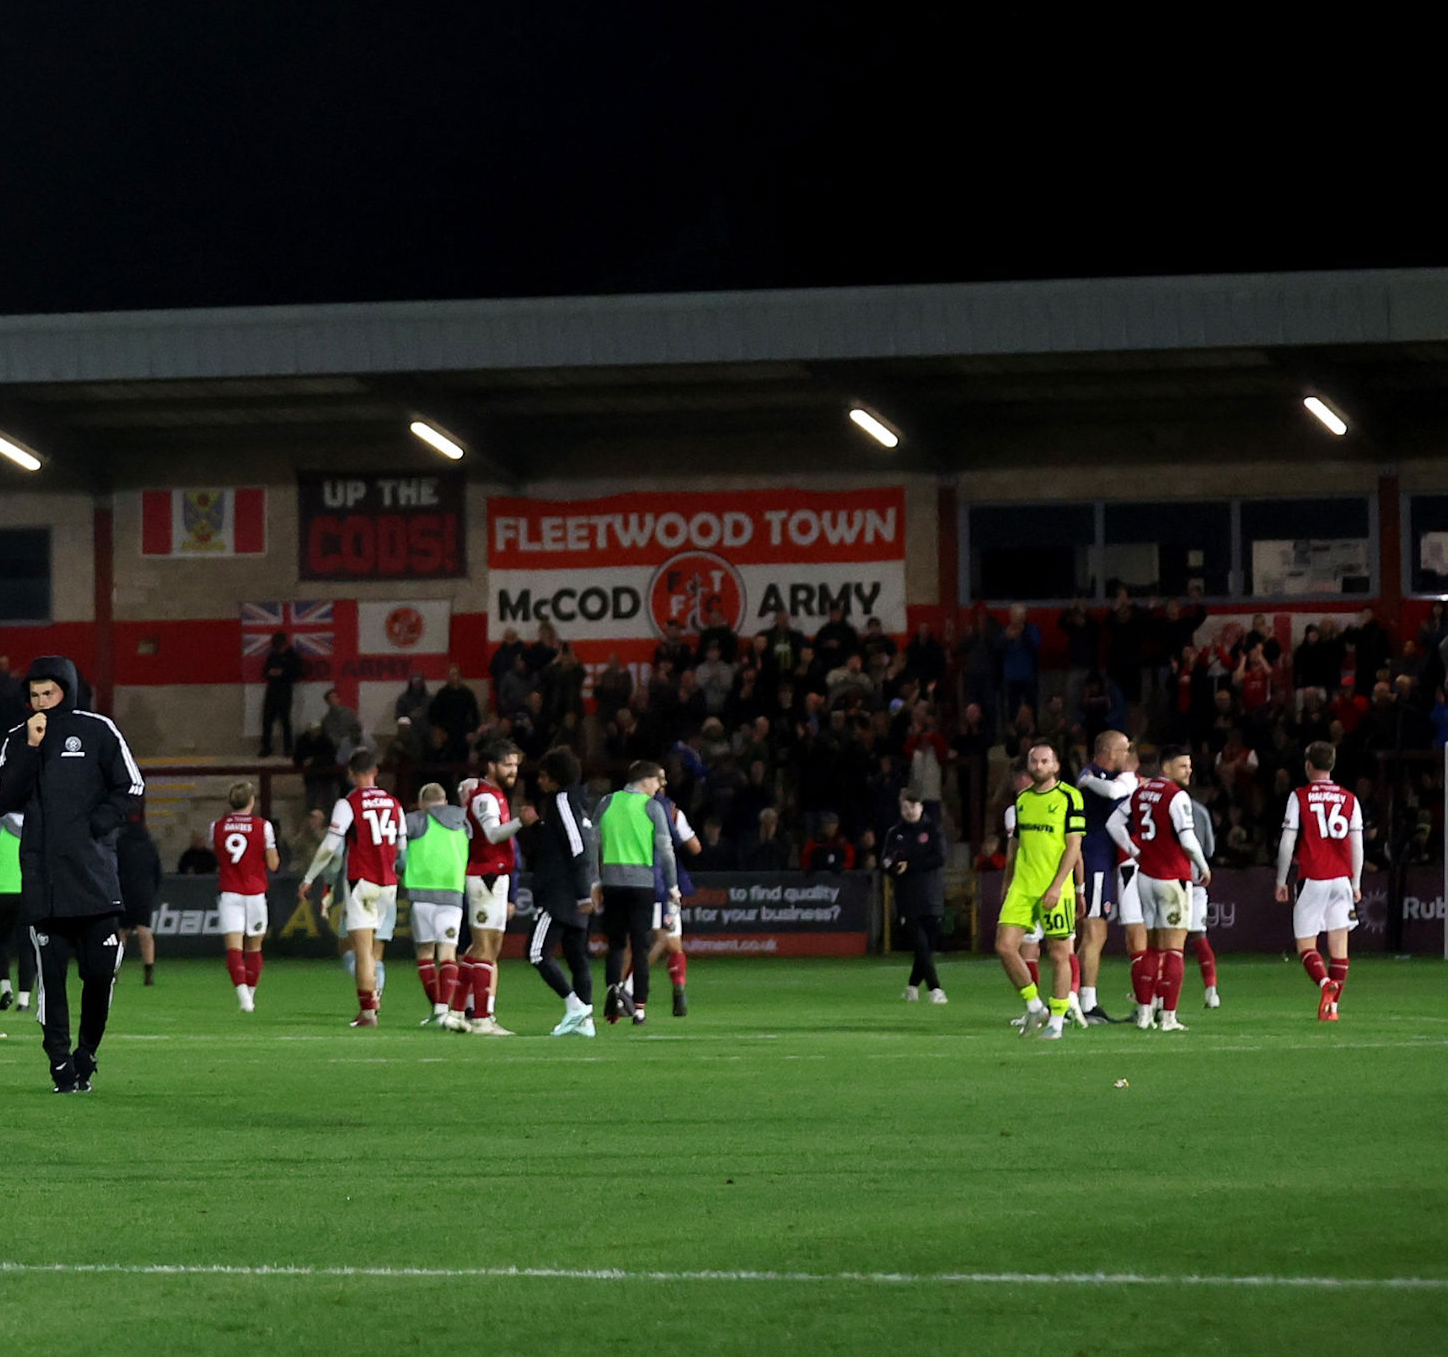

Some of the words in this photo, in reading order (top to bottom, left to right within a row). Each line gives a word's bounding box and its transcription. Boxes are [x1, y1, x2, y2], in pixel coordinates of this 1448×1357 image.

[323, 479, 367, 508] UP
[376, 477, 440, 507] THE
[308, 513, 458, 574] CODS!
[494, 511, 754, 552] FLEETWOOD
[764, 506, 897, 546] TOWN
[498, 586, 642, 623] McCOD
[758, 582, 882, 618] ARMY
[362, 809, 397, 845] 14
[1139, 802, 1156, 841] 3
[1310, 803, 1349, 839] 16
[224, 833, 248, 864] 9
[750, 885, 781, 901] find
[784, 885, 841, 905] quality
[721, 908, 757, 925] your
[761, 905, 842, 922] business?
[1044, 913, 1064, 932] 30
